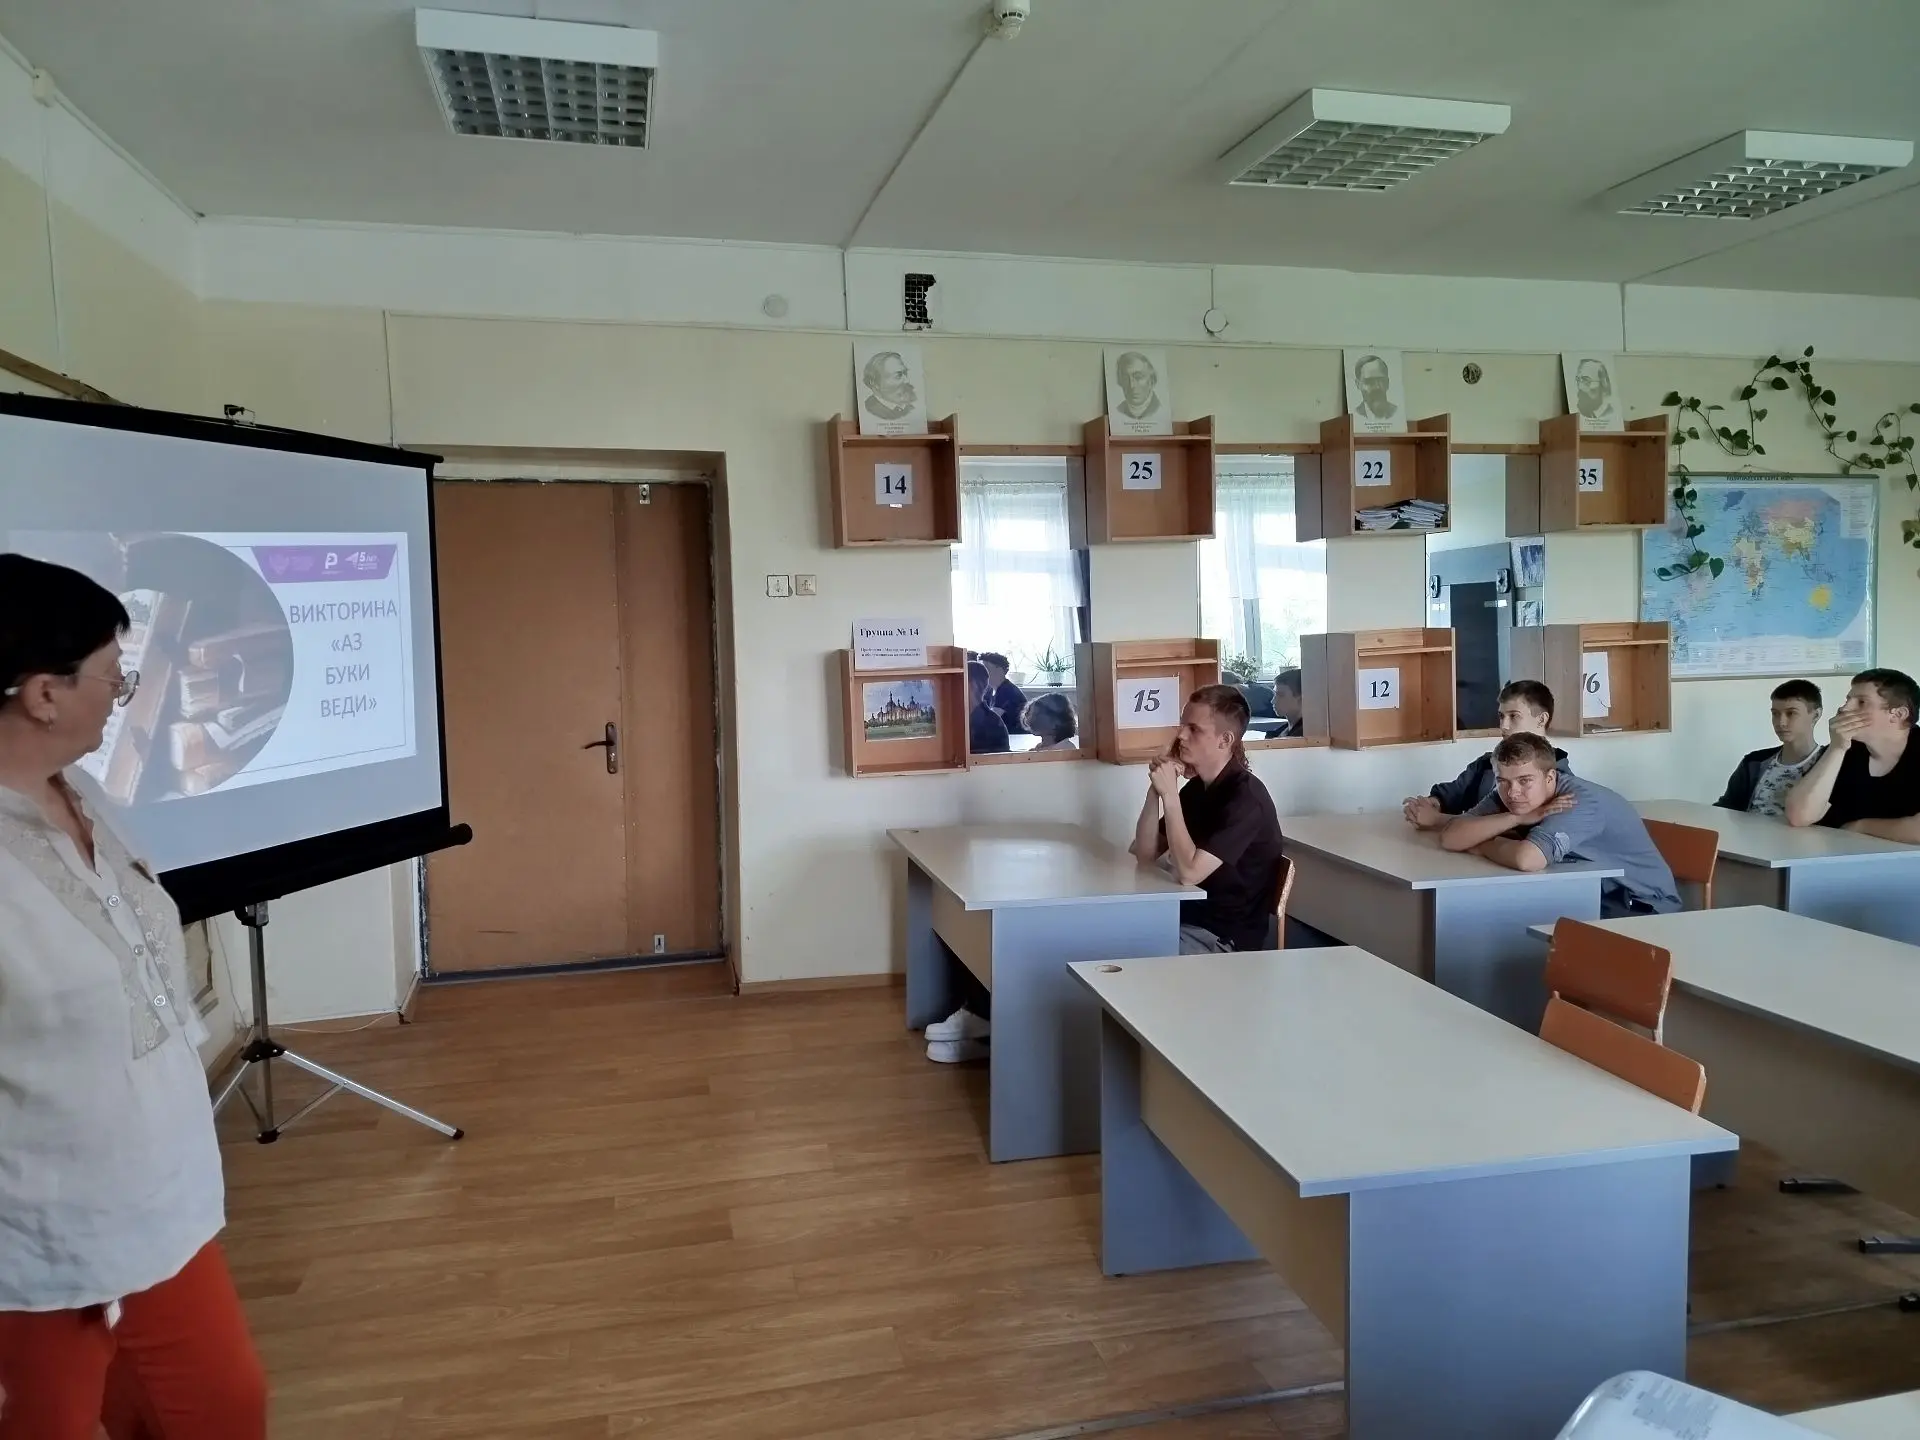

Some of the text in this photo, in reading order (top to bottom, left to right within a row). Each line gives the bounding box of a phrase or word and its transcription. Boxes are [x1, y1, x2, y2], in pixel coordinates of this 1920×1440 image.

[1129, 461, 1153, 480] 25
[1362, 461, 1384, 479] 22
[1579, 468, 1597, 485] 35
[882, 475, 907, 494] 14
[289, 599, 398, 624] ВИКТОРИНА
[331, 632, 363, 652] «АЗ
[860, 628, 893, 638] Группа
[909, 628, 919, 636] 14
[325, 663, 370, 685] БУКИ
[1370, 680, 1390, 698] 12
[320, 694, 378, 719] ВЕДИ»
[1134, 689, 1160, 712] 15
